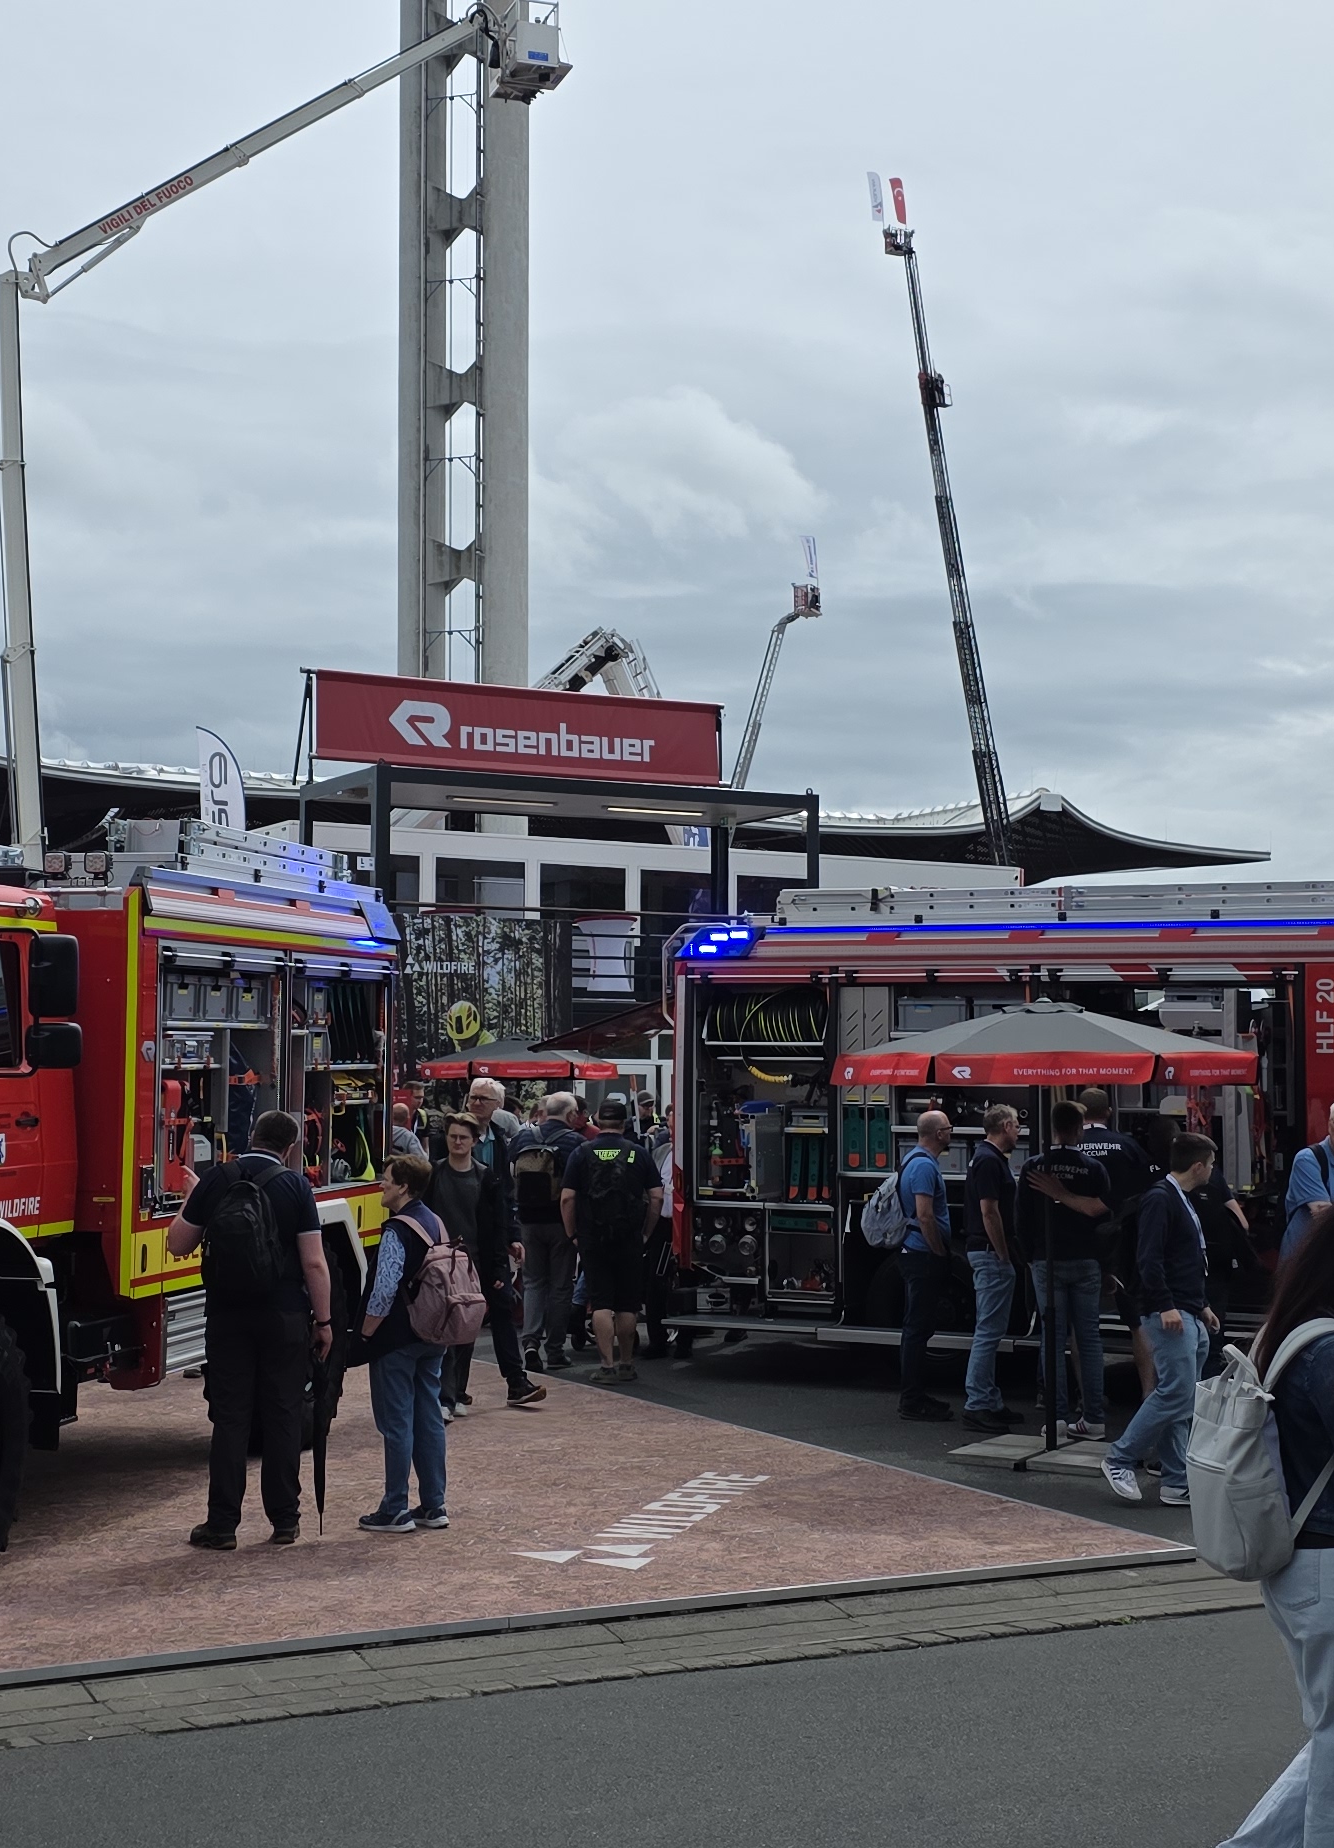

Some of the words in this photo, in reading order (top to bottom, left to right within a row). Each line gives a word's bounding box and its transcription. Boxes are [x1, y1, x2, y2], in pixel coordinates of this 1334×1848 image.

[98, 209, 134, 234] VIGILI
[133, 197, 157, 216] DEL
[155, 175, 194, 203] FUOCO
[460, 722, 655, 763] rosenbauer
[422, 961, 475, 974] WILDFIRE
[1316, 978, 1334, 1003] 20
[1316, 1010, 1334, 1053] HLF
[1013, 1067, 1060, 1076] EVERYTHING
[1099, 1067, 1136, 1075] MOMENT.
[1077, 1142, 1122, 1151] UERWEHR
[1036, 1164, 1089, 1175] FERWEHR
[593, 1471, 771, 1539] WILDFIRE
